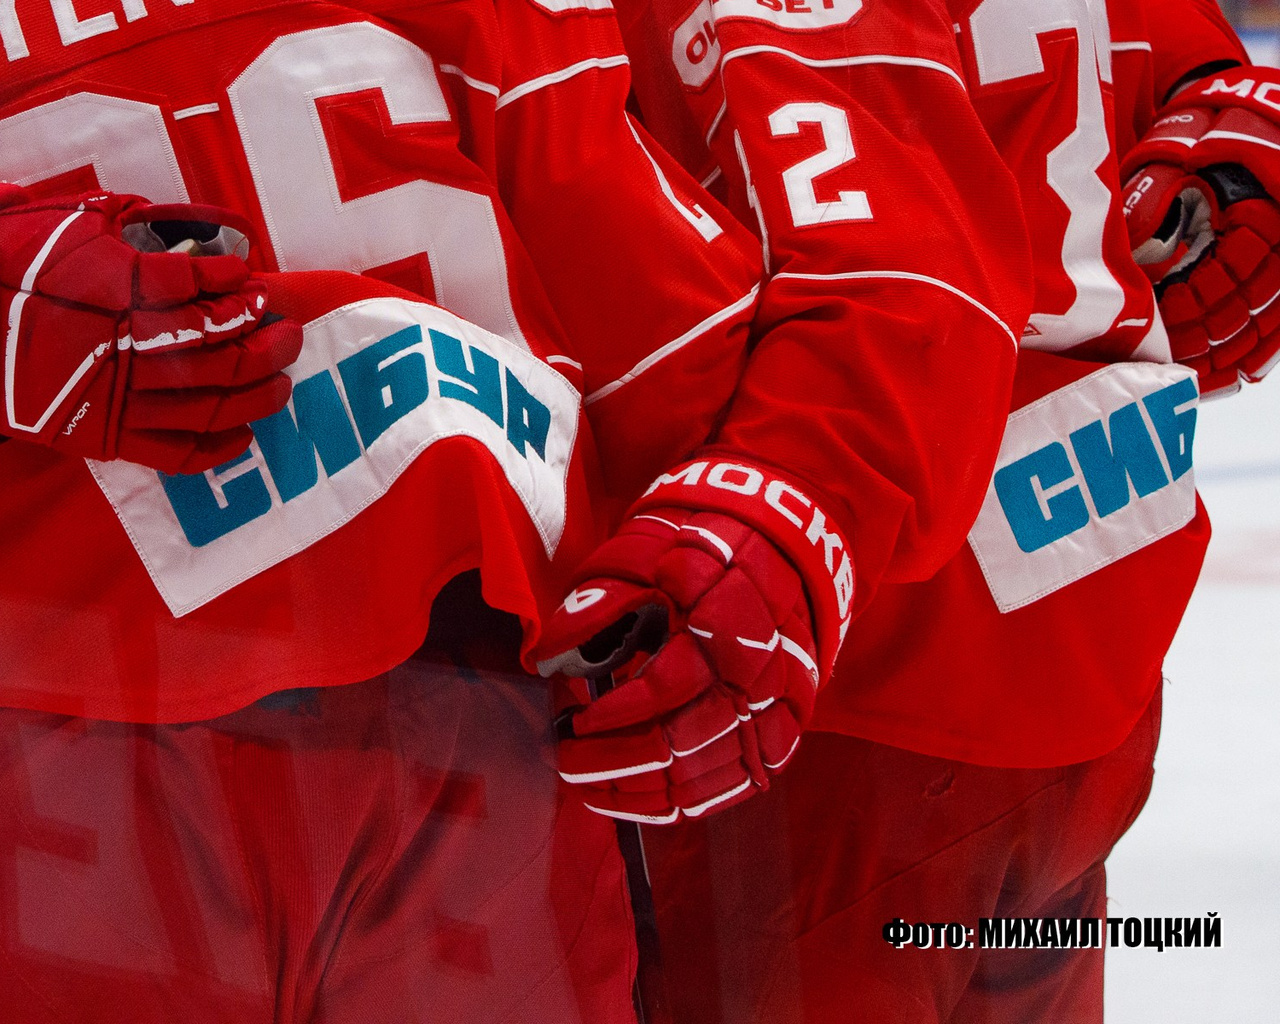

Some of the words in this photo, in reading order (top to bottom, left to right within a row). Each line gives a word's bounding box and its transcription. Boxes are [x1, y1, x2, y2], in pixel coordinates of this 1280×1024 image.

[62, 401, 91, 435] VAPOR
[157, 323, 552, 548] СИБУР
[993, 376, 1199, 554] СИБ
